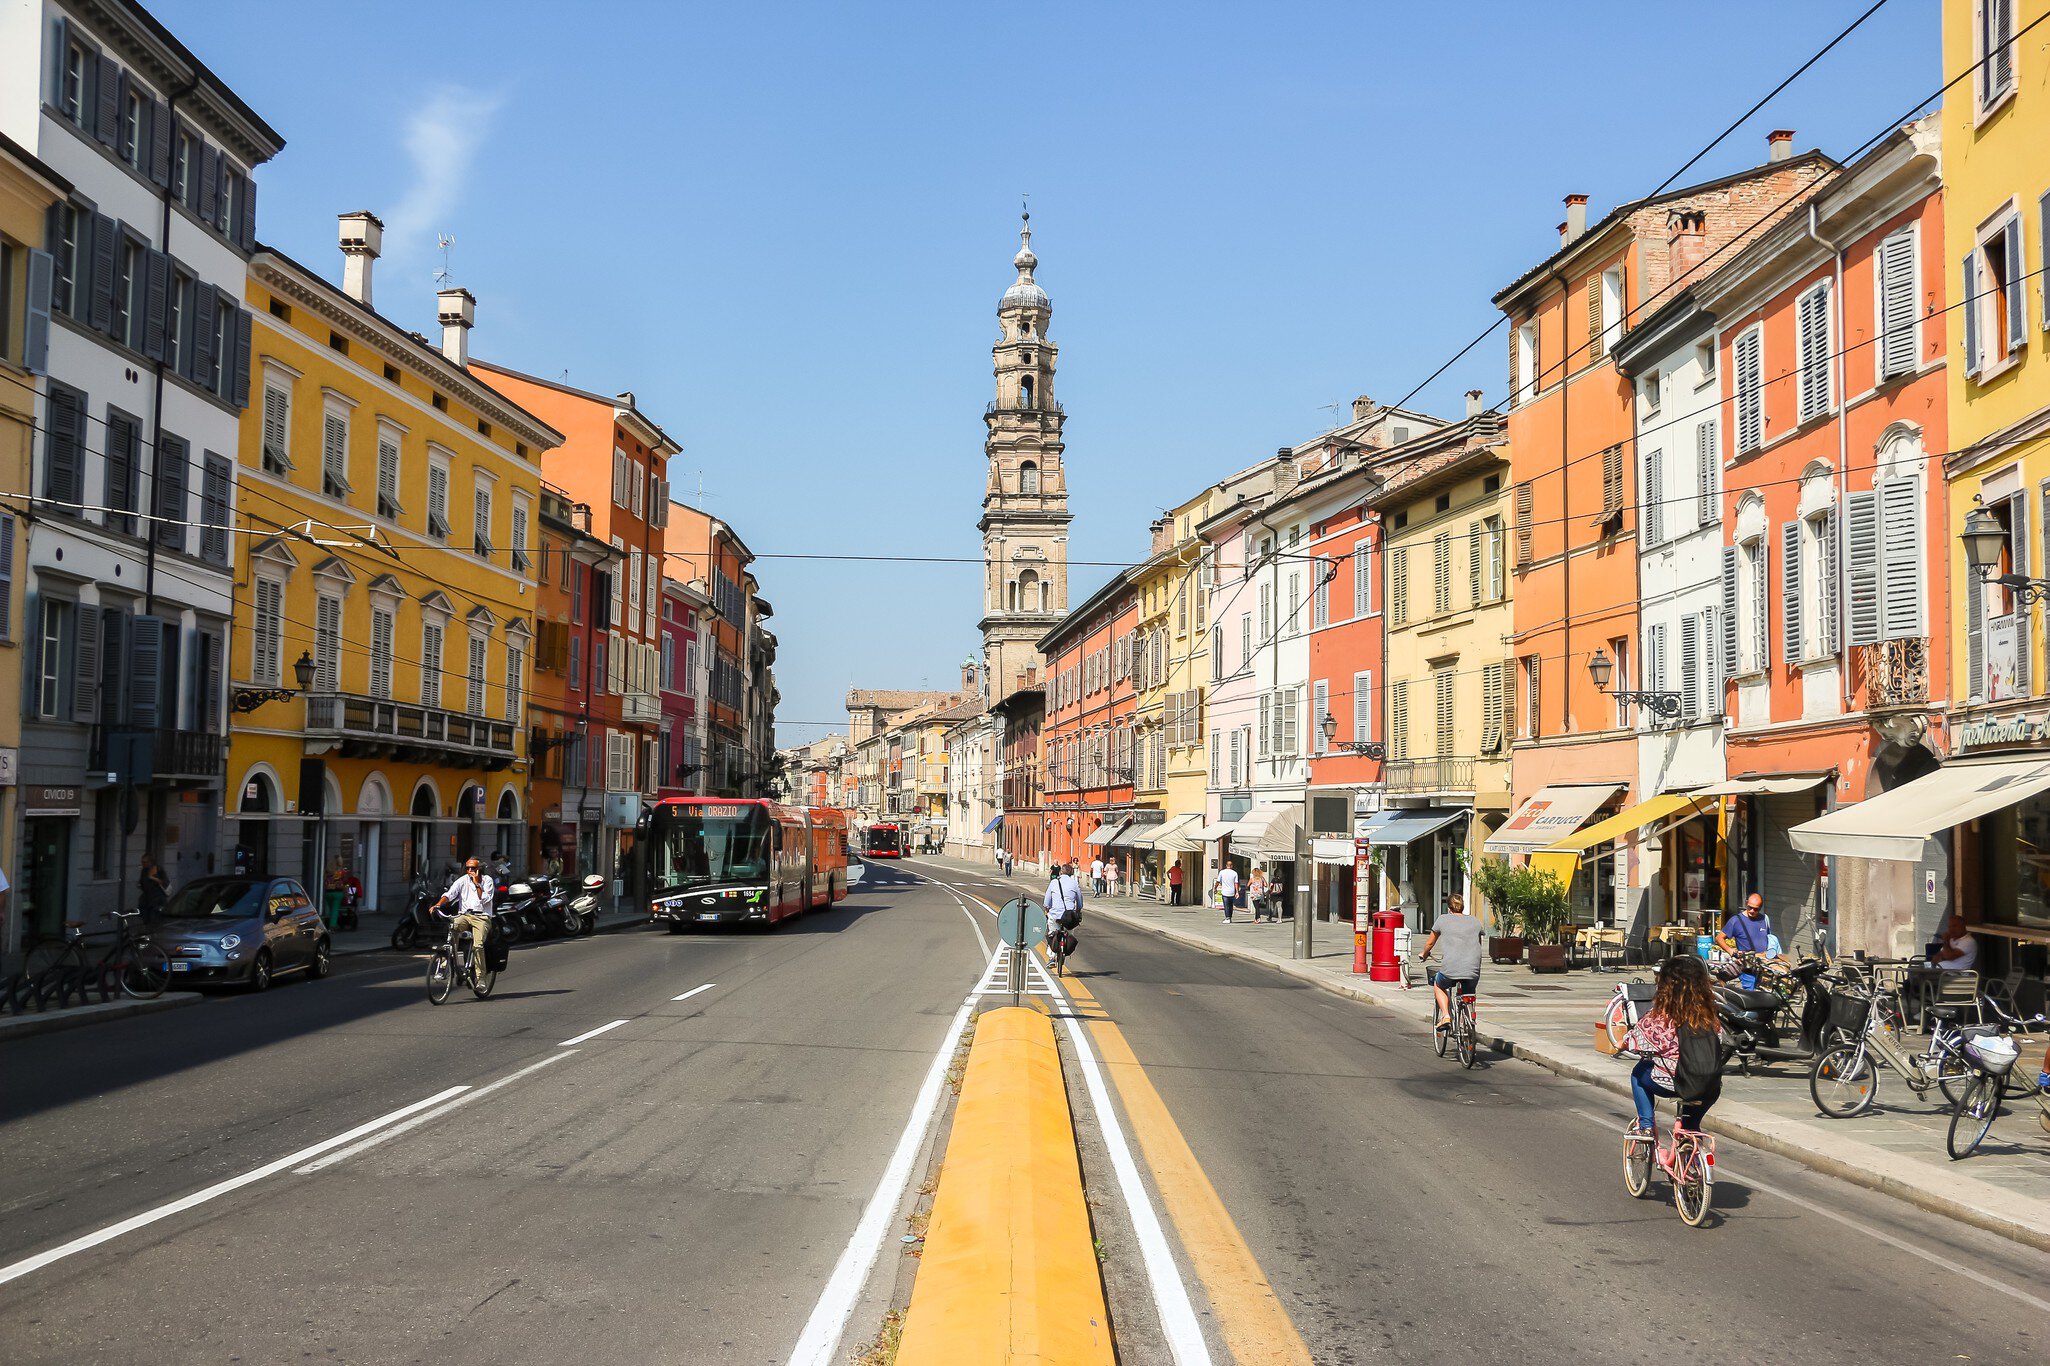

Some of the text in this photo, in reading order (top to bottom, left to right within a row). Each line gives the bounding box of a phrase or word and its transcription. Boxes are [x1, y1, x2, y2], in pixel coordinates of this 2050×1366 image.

[43, 789, 75, 800] CIVICO 19
[477, 787, 484, 802] P
[671, 805, 738, 817] 5 Via ORAZIO
[1520, 808, 1544, 818] ECO
[1535, 815, 1583, 825] CARTUCCE
